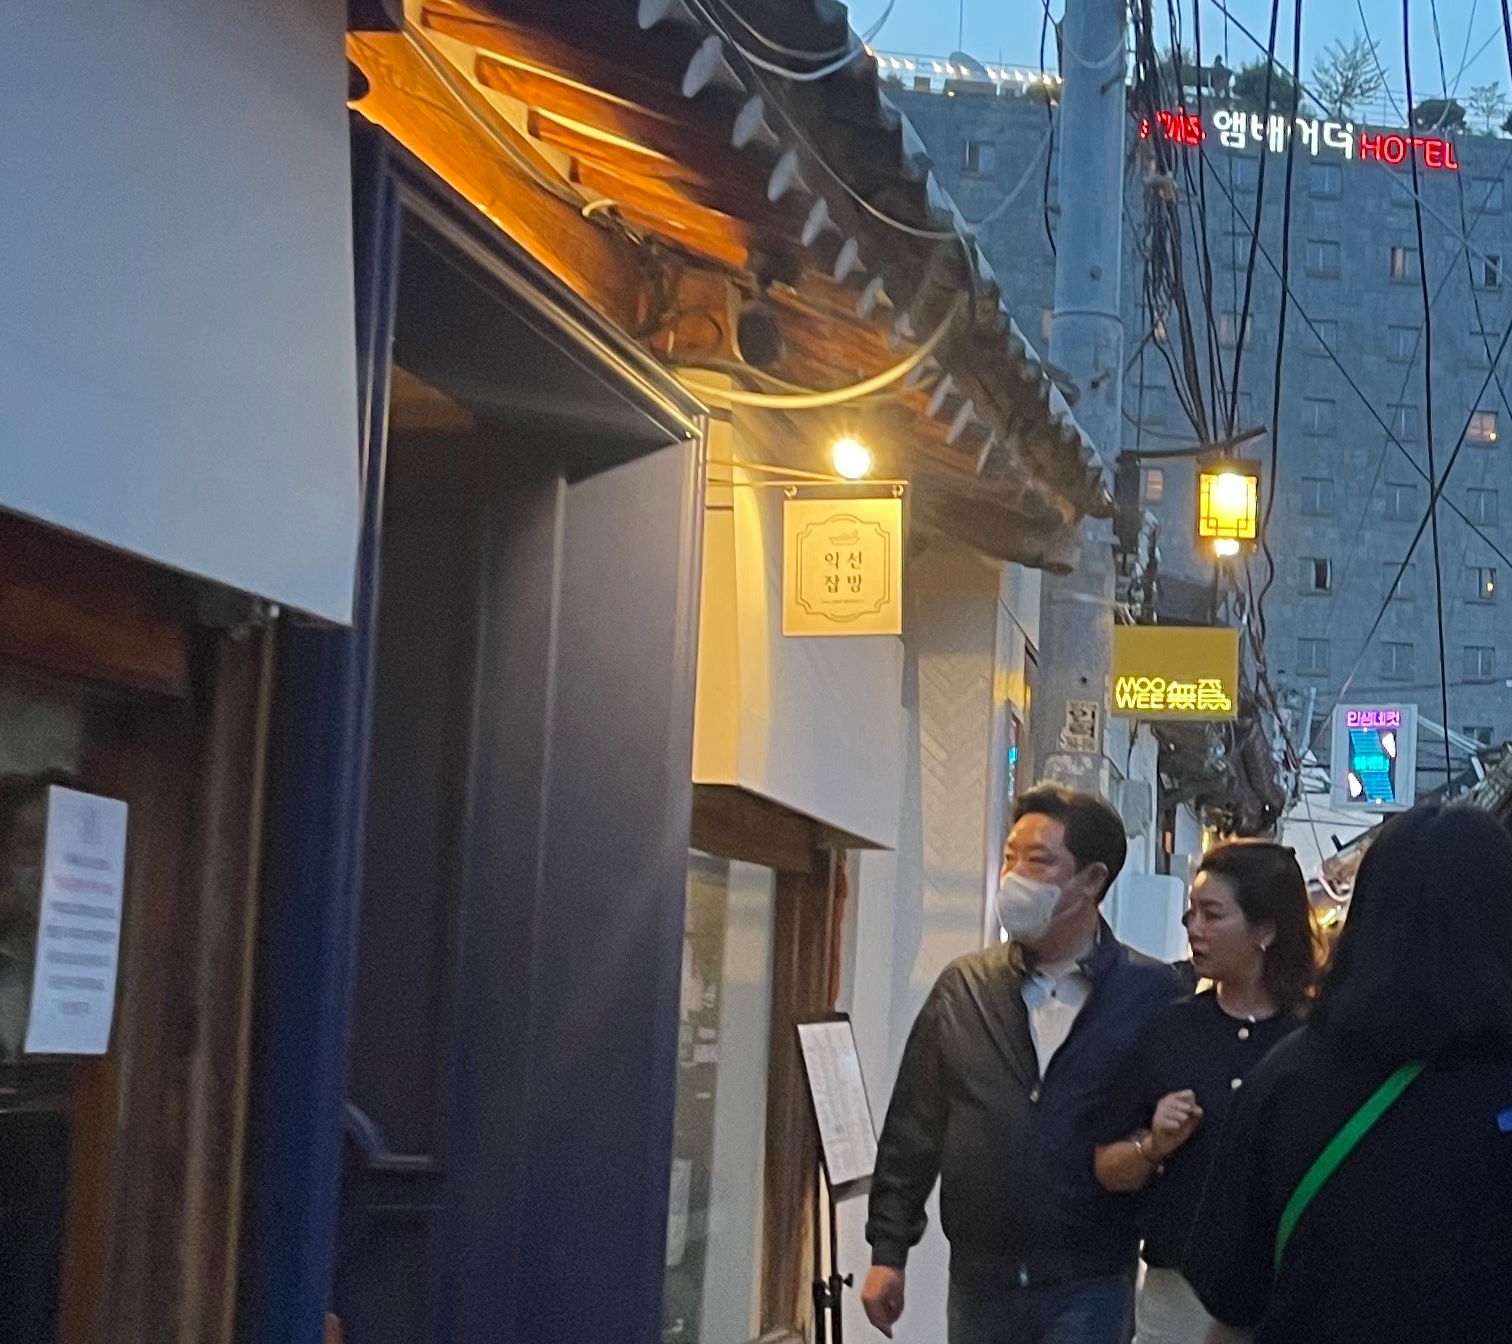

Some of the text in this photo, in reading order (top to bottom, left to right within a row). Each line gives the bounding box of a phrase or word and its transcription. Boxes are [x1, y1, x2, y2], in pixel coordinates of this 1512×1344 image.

[824, 551, 862, 570] 익선
[1116, 676, 1166, 693] MOO
[1116, 692, 1165, 709] WEE
[1347, 710, 1400, 726] 인생네컷
